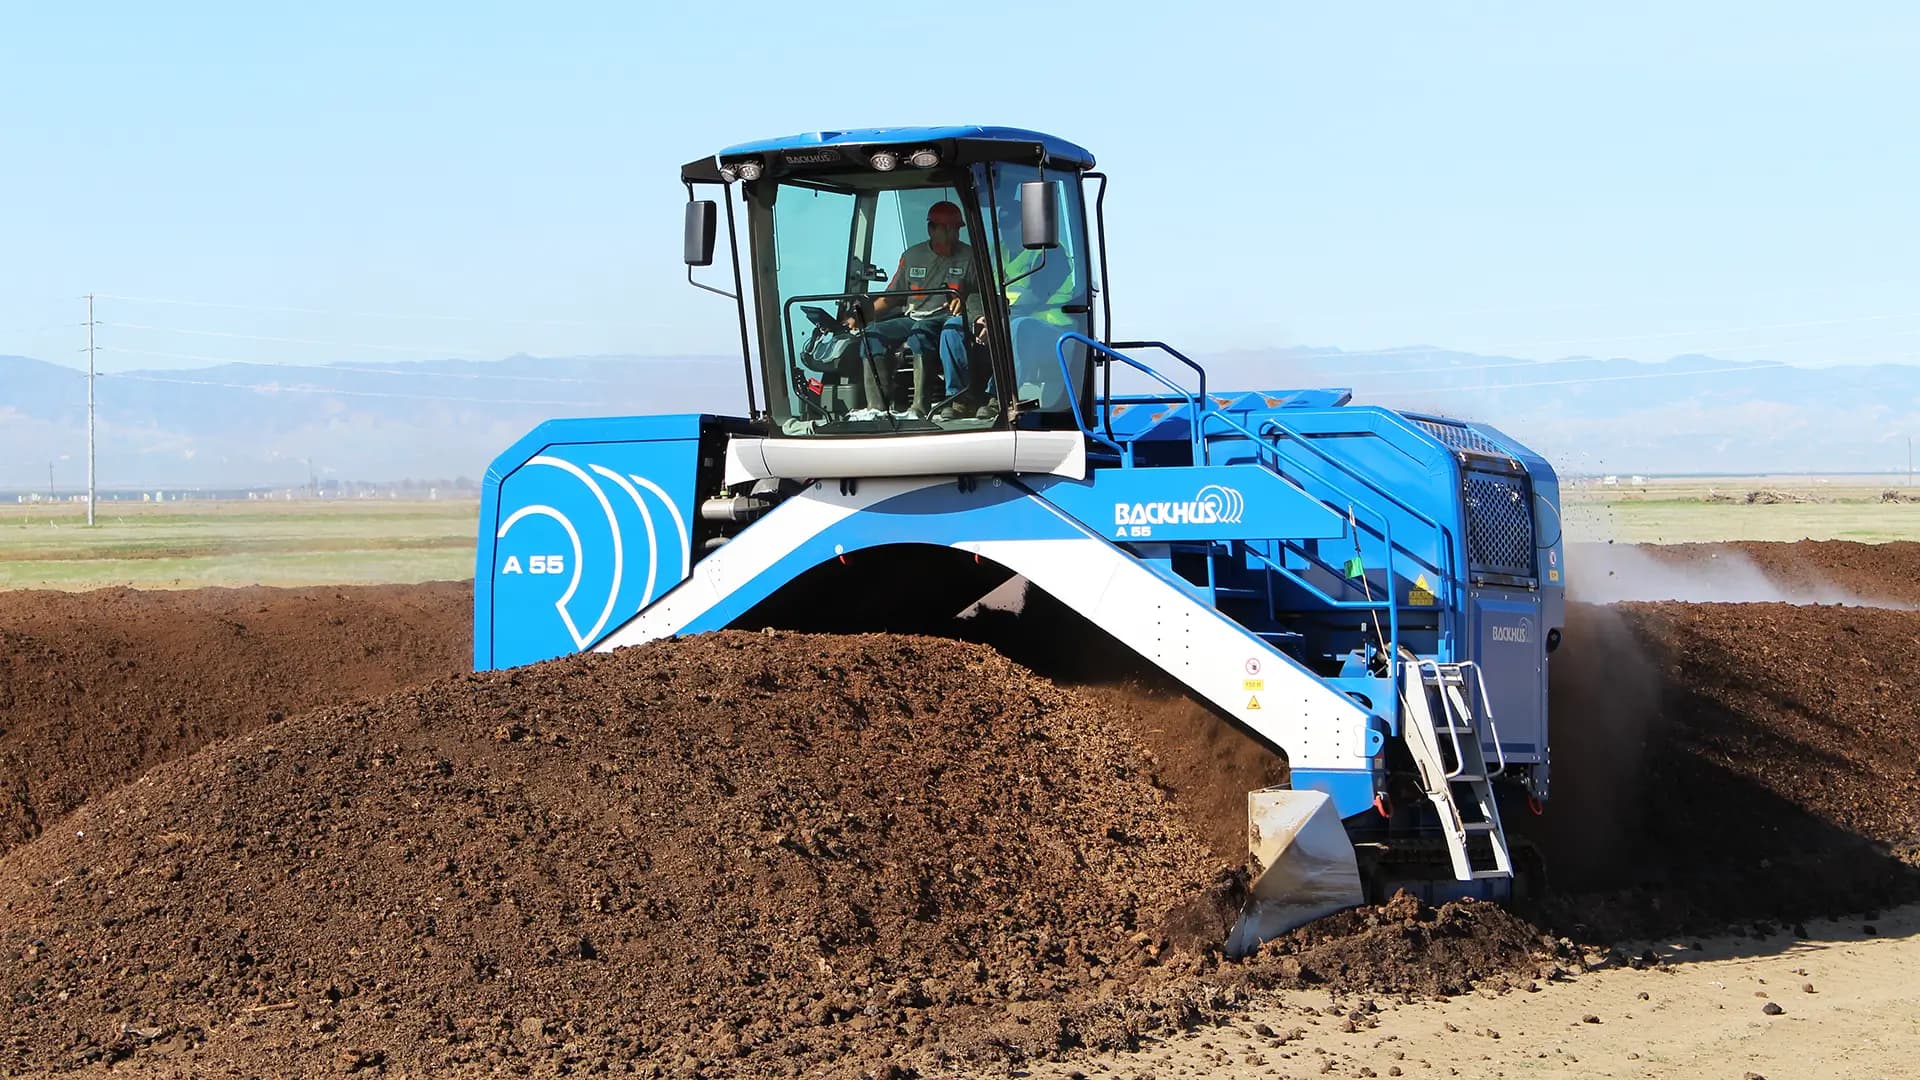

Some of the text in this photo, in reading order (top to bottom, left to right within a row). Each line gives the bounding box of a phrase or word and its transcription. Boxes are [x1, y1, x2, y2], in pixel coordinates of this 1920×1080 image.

[786, 154, 832, 164] BACKHUS
[1115, 502, 1218, 525] BACKHUS
[1115, 526, 1152, 537] A 55
[501, 555, 564, 574] A 55
[1492, 626, 1526, 643] BACKHUS
